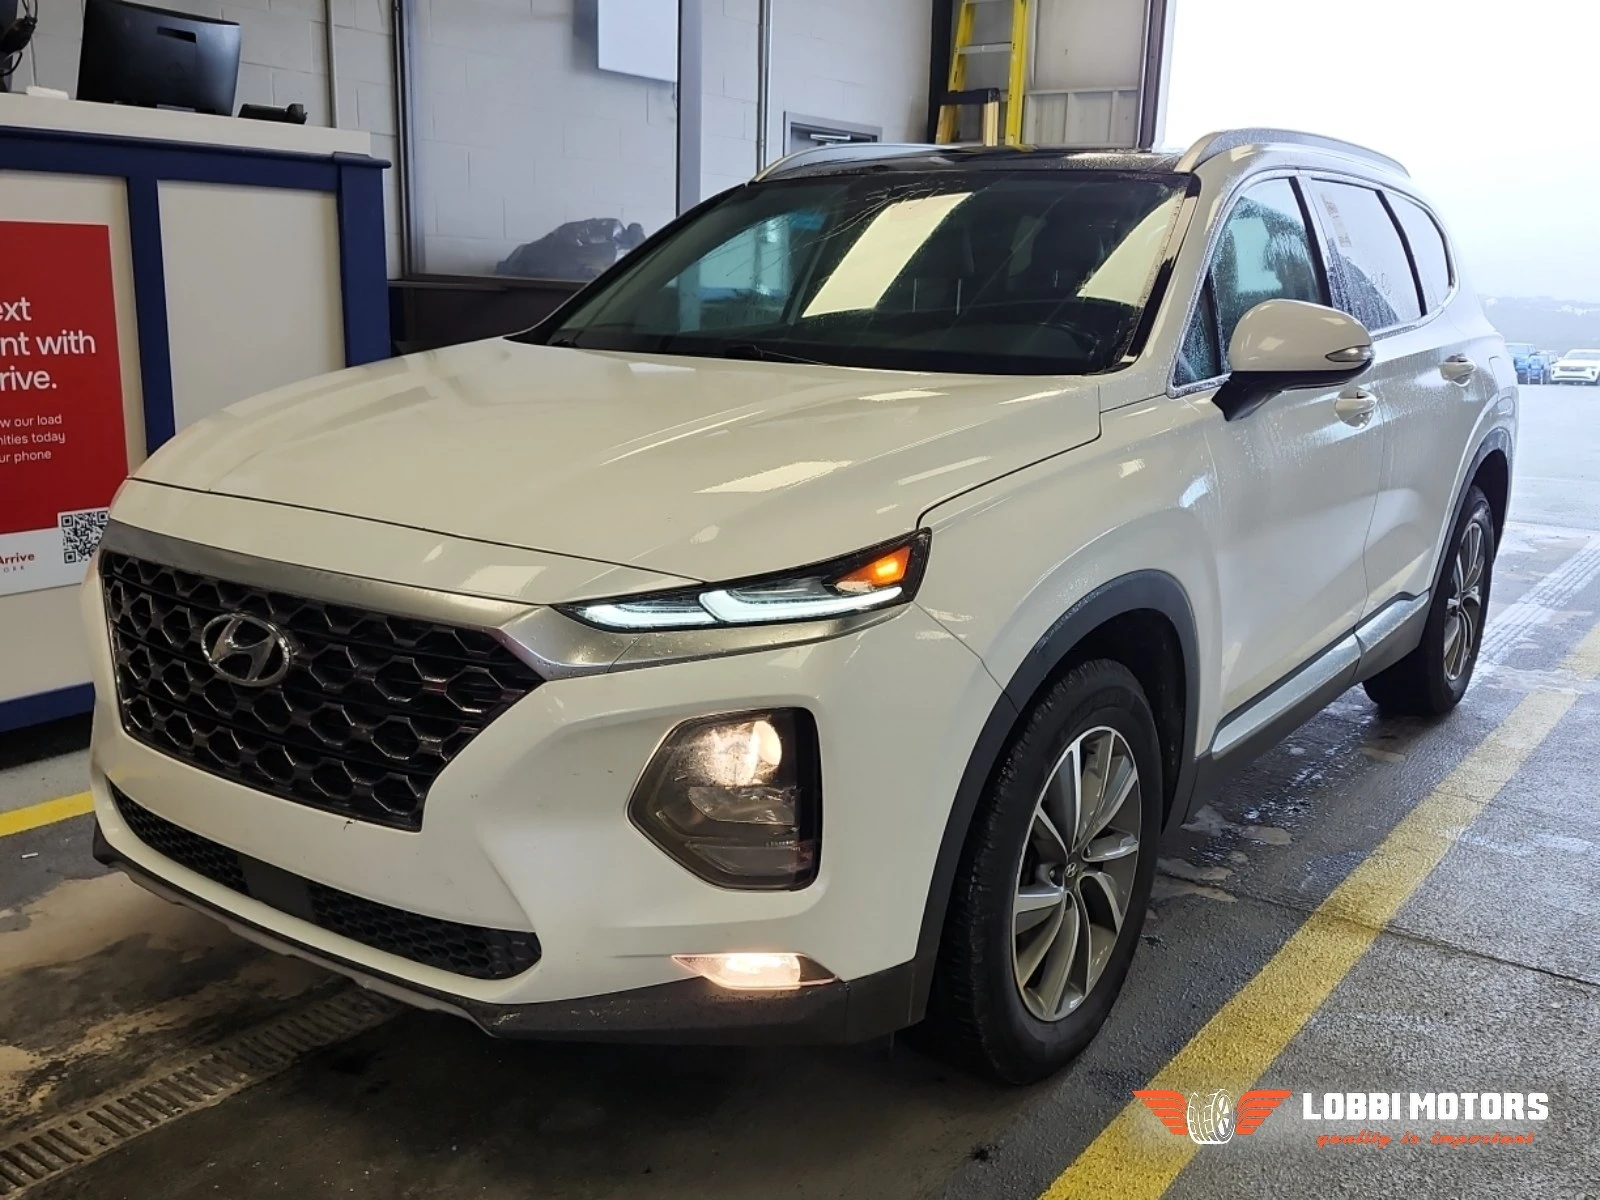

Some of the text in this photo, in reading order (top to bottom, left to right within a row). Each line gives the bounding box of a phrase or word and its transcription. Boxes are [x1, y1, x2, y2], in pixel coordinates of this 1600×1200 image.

[36, 329, 96, 355] with
[0, 365, 57, 391] rive.
[14, 417, 34, 427] our
[37, 413, 62, 425] load
[32, 431, 65, 444] today
[14, 450, 52, 464] phone
